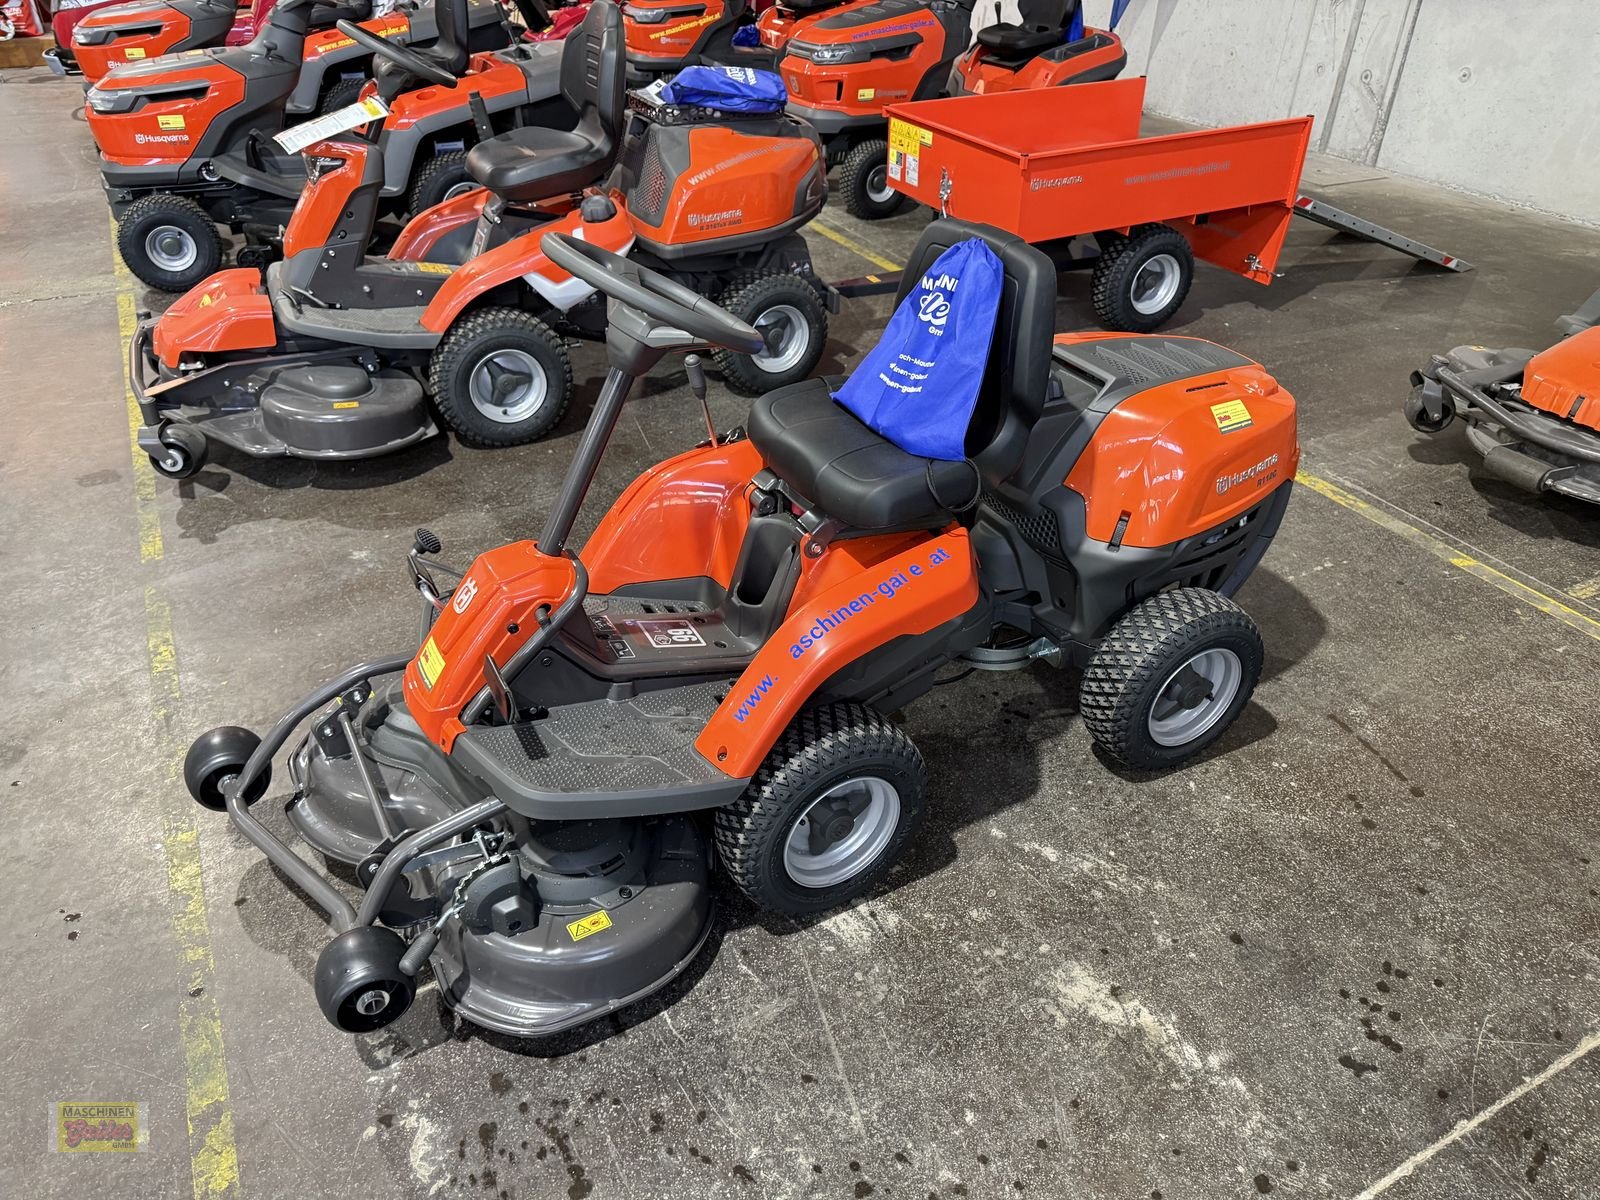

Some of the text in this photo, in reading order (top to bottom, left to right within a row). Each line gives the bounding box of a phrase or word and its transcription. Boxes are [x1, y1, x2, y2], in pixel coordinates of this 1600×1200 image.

[145, 134, 190, 144] Husqvarna
[697, 208, 743, 225] Husqvarna
[1228, 452, 1279, 489] Husqvarna
